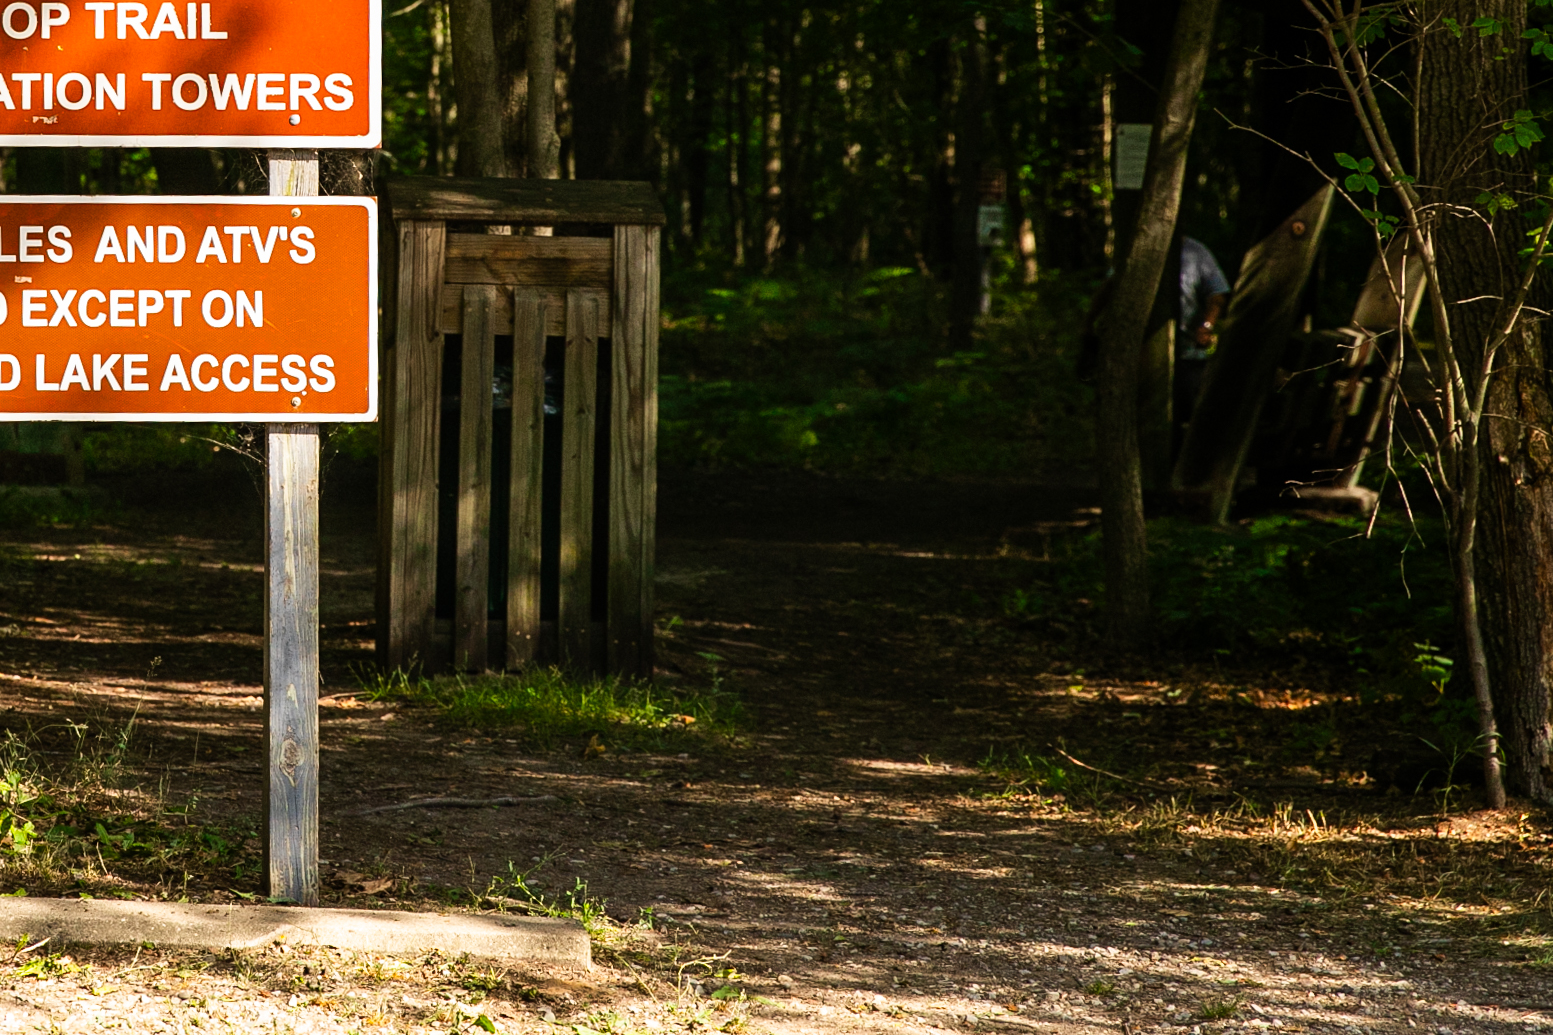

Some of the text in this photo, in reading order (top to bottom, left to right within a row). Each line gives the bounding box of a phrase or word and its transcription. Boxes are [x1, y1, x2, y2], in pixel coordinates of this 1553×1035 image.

[84, 1, 228, 40] TRAIL
[141, 72, 354, 112] TOWERS
[93, 225, 187, 264] AND
[195, 225, 316, 265] ATV'S
[21, 288, 192, 328] EXCEPT
[201, 289, 264, 328] ON
[35, 353, 150, 392] LAKE
[159, 353, 336, 393] ACCESS
